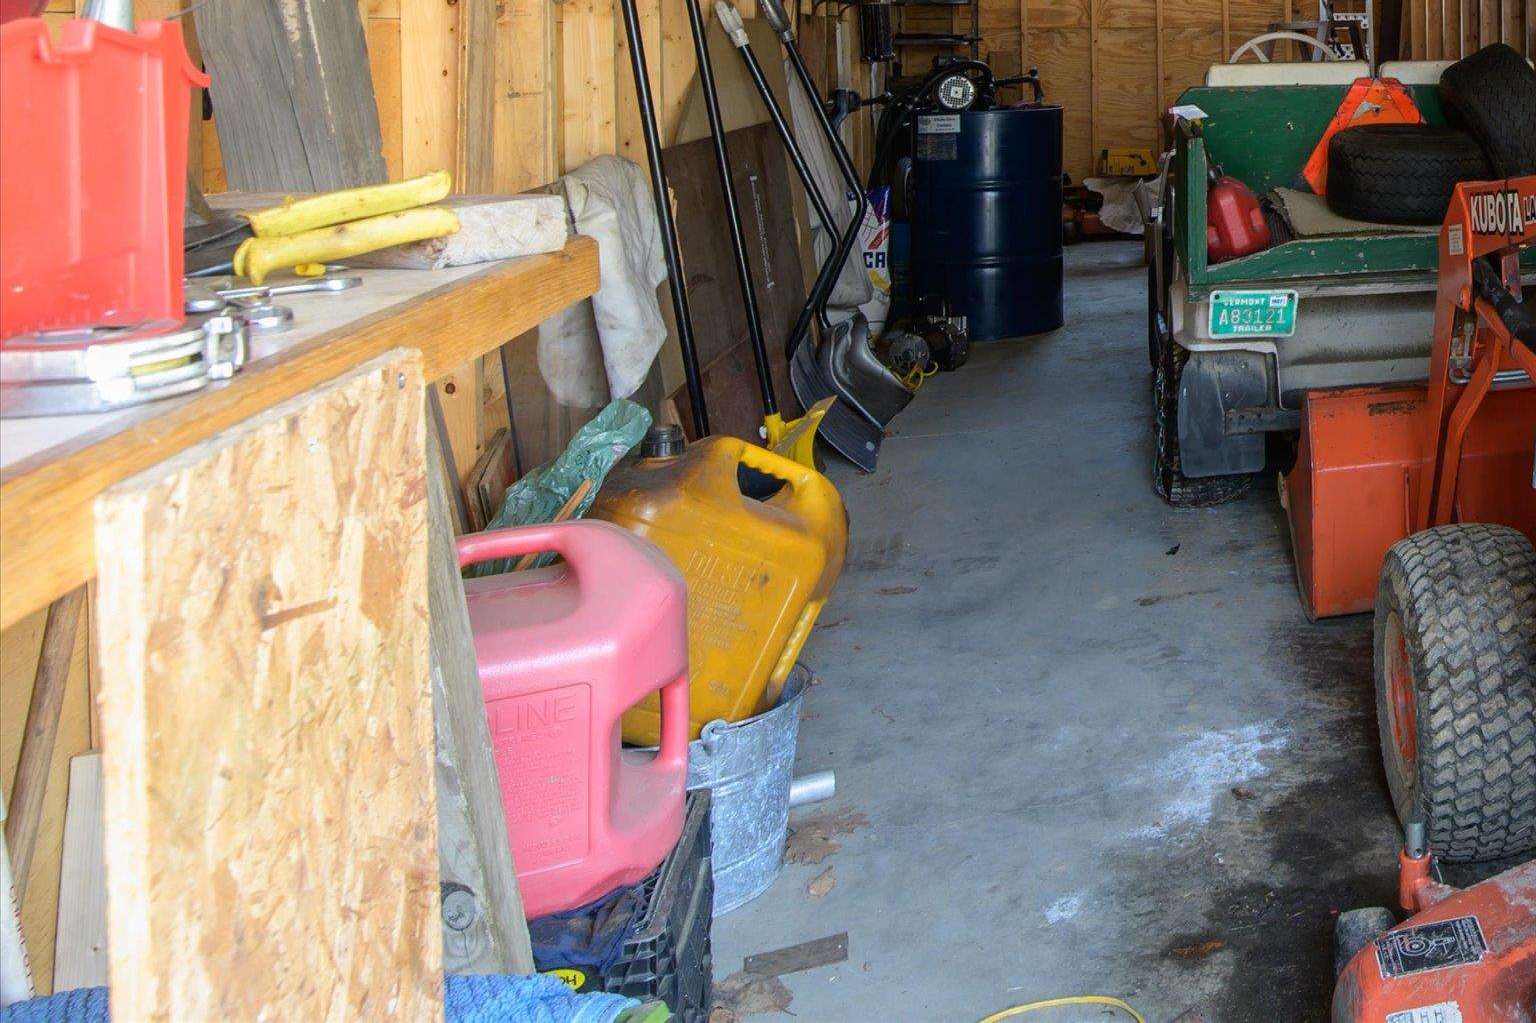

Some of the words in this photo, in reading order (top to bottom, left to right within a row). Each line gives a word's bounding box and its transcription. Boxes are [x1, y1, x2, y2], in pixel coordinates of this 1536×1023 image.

[1469, 191, 1524, 235] KUBOTA
[1233, 324, 1273, 333] TRAILER
[489, 693, 576, 738] LINE
